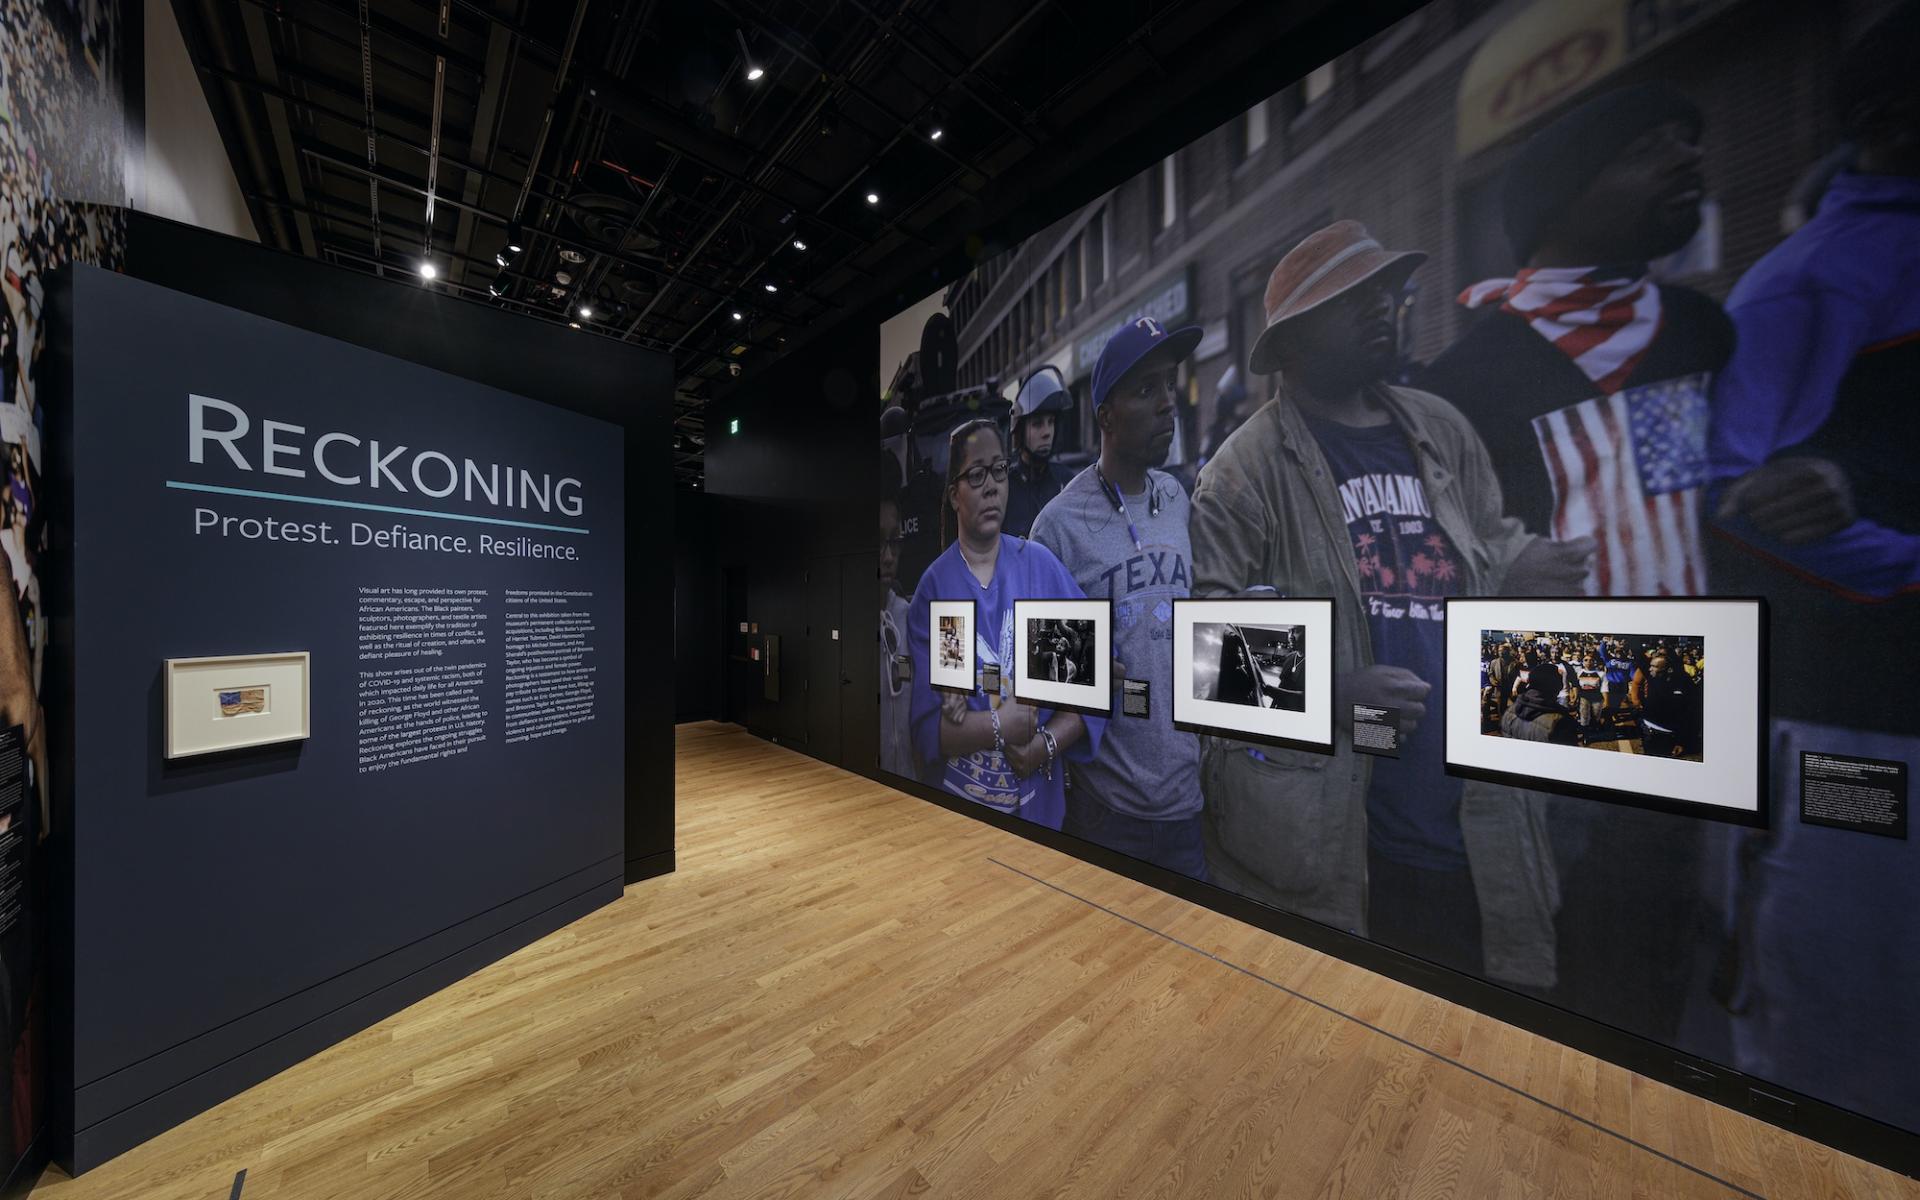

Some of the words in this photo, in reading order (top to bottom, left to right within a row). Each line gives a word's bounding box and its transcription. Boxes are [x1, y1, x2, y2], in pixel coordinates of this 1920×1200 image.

[189, 393, 583, 517] RECKONING
[195, 508, 339, 544] Protest.
[352, 522, 472, 554] Defiance.
[480, 534, 580, 561] Resilience.
[900, 517, 918, 534] LICE
[1100, 552, 1190, 598] TEXA
[404, 588, 418, 596] long
[359, 615, 392, 623] sculptors,
[393, 614, 440, 622] photographers,
[384, 651, 412, 660] pleasure
[359, 689, 379, 698] which
[381, 685, 411, 696] impacted
[412, 684, 426, 692] daily
[455, 679, 483, 687] Americans
[368, 678, 400, 688] COVID-19
[401, 676, 413, 684] and
[415, 675, 440, 684] systemic
[423, 700, 440, 708] world
[442, 696, 469, 706] witnessed
[445, 688, 462, 697] called
[359, 718, 378, 726] killing
[389, 713, 412, 722] George
[414, 709, 430, 718] Floyd
[431, 708, 442, 716] and
[444, 706, 459, 714] other
[460, 704, 480, 712] African
[359, 725, 395, 736] Americans
[415, 718, 433, 727] hands
[443, 715, 461, 724] police,
[462, 712, 481, 720] leading
[359, 737, 378, 745] some
[379, 734, 387, 742] of
[400, 729, 421, 738] largest
[423, 725, 447, 736] protests
[359, 743, 394, 754] Reckoning
[395, 738, 421, 748] explores
[423, 735, 433, 743] the
[434, 732, 457, 741] ongoing
[359, 754, 377, 764] Black
[378, 749, 413, 760] Americans
[429, 741, 446, 751] faced
[453, 738, 466, 747] their
[467, 734, 486, 745] pursuit
[368, 763, 387, 772] enjoy
[388, 760, 399, 768] the
[400, 751, 439, 766] fundamental
[440, 749, 456, 758] rights
[457, 746, 468, 754] and
